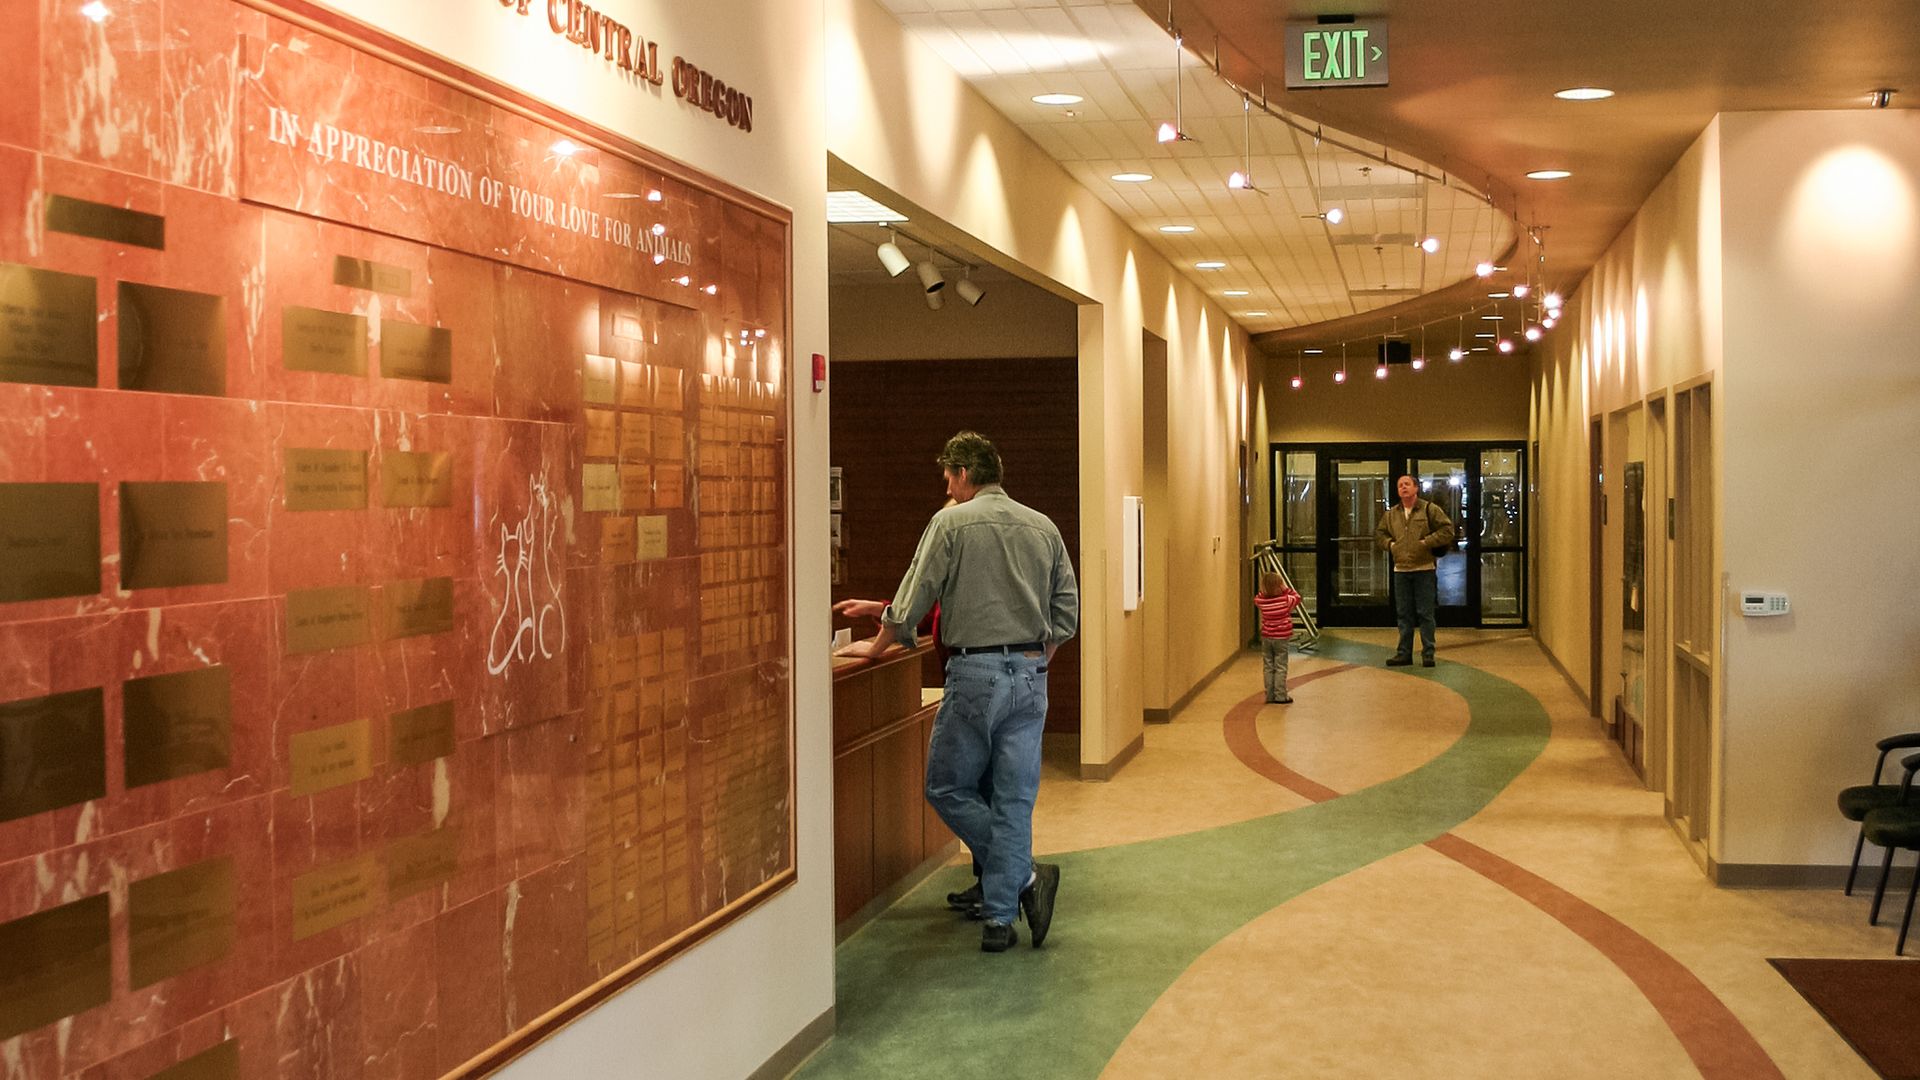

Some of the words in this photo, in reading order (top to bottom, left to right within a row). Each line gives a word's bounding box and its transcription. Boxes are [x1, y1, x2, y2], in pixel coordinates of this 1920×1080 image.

[548, 0, 663, 86] CENTRAL
[672, 56, 753, 133] OREGON
[1303, 30, 1369, 80] EXIT
[269, 107, 299, 148] IN
[307, 121, 473, 200] APPRECIATION
[479, 176, 504, 208] OF
[509, 185, 556, 226] YOUR
[561, 202, 600, 239] LOVE
[605, 216, 632, 248] FOR
[636, 227, 692, 266] ANIMALS
